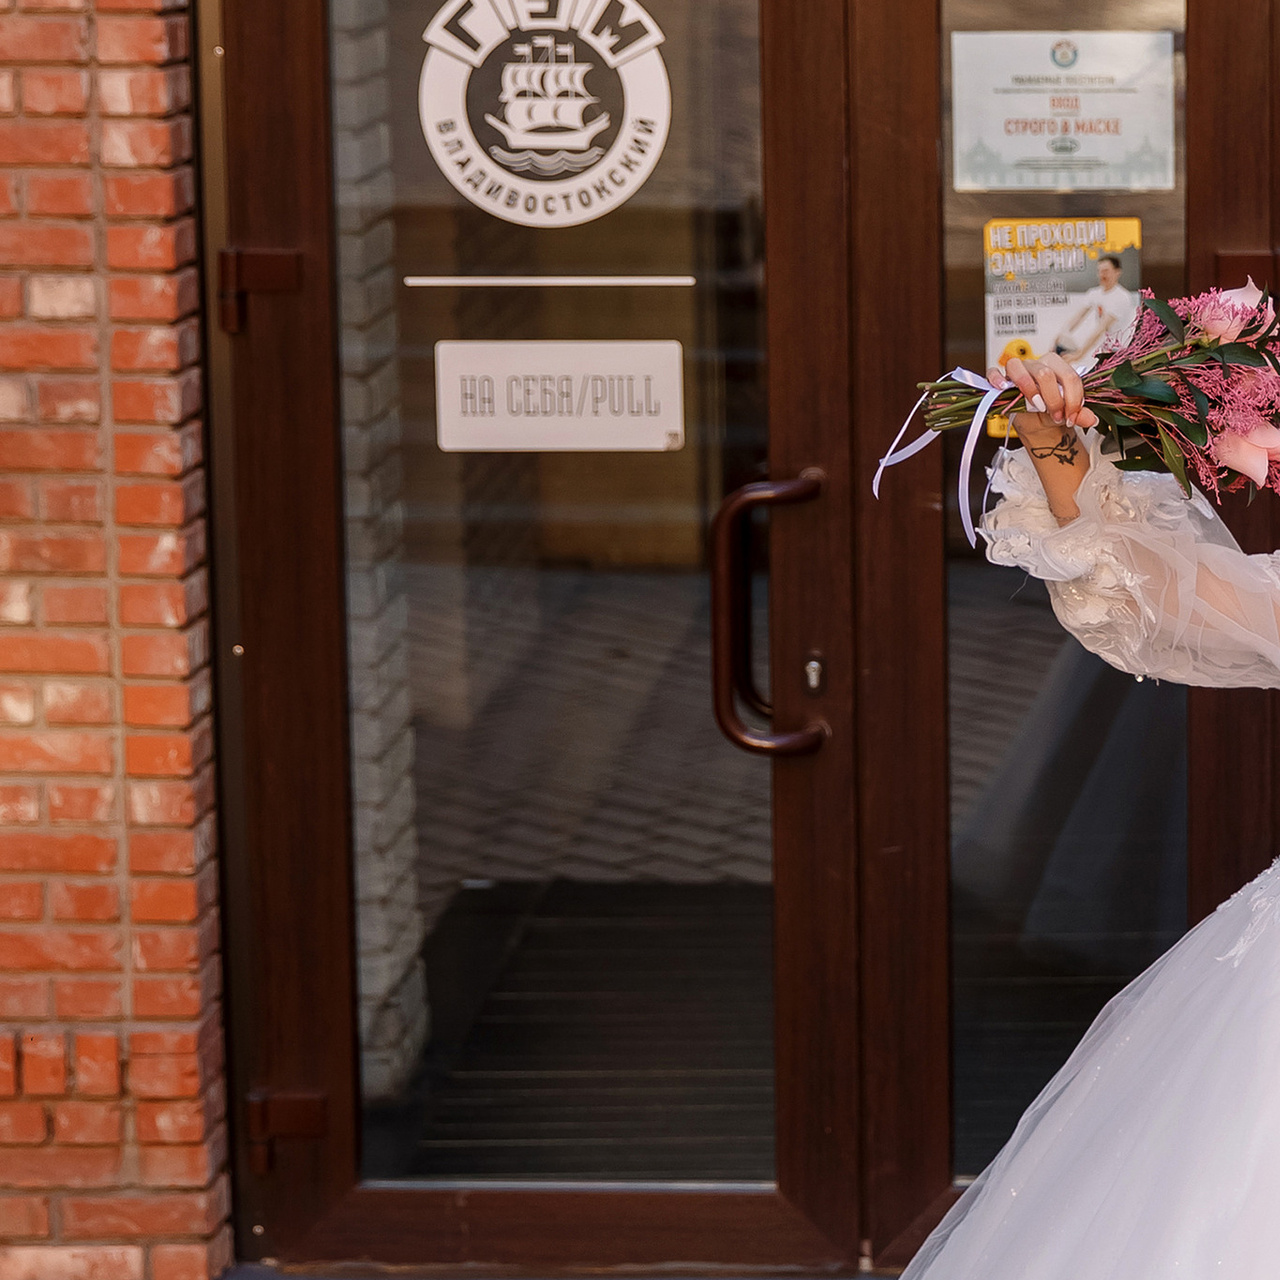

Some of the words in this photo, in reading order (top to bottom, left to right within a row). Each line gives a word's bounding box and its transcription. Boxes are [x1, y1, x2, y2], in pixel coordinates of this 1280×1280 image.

[1004, 118, 1058, 136] СТРОГО
[1074, 118, 1122, 136] МАСКЕ
[436, 116, 656, 216] ВЛАДИВОСТОКСКИЙ
[989, 226, 1013, 249] НЕ
[1016, 219, 1106, 247] ПРОХОДИ!
[459, 373, 496, 418] НА
[506, 373, 661, 418] СЕБЯ/PULL
